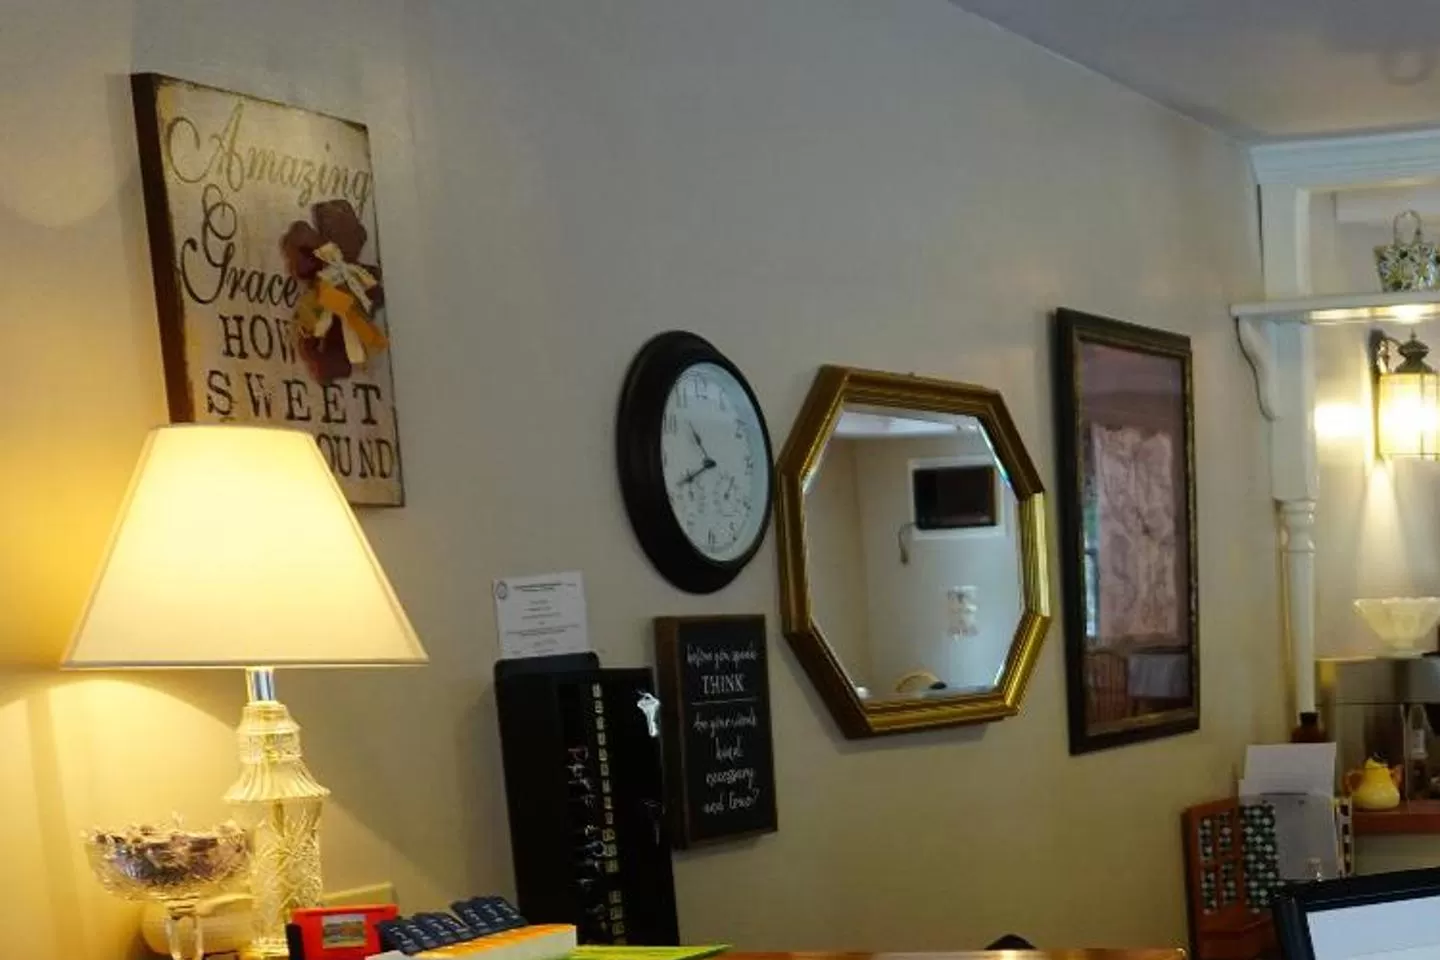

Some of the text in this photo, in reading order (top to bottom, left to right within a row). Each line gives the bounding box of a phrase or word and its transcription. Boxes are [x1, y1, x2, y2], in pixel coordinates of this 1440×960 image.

[166, 102, 373, 211] Amazing
[180, 184, 298, 306] Grace
[206, 369, 381, 424] SWEET
[315, 432, 394, 479] OUND
[701, 673, 745, 695] THINK
